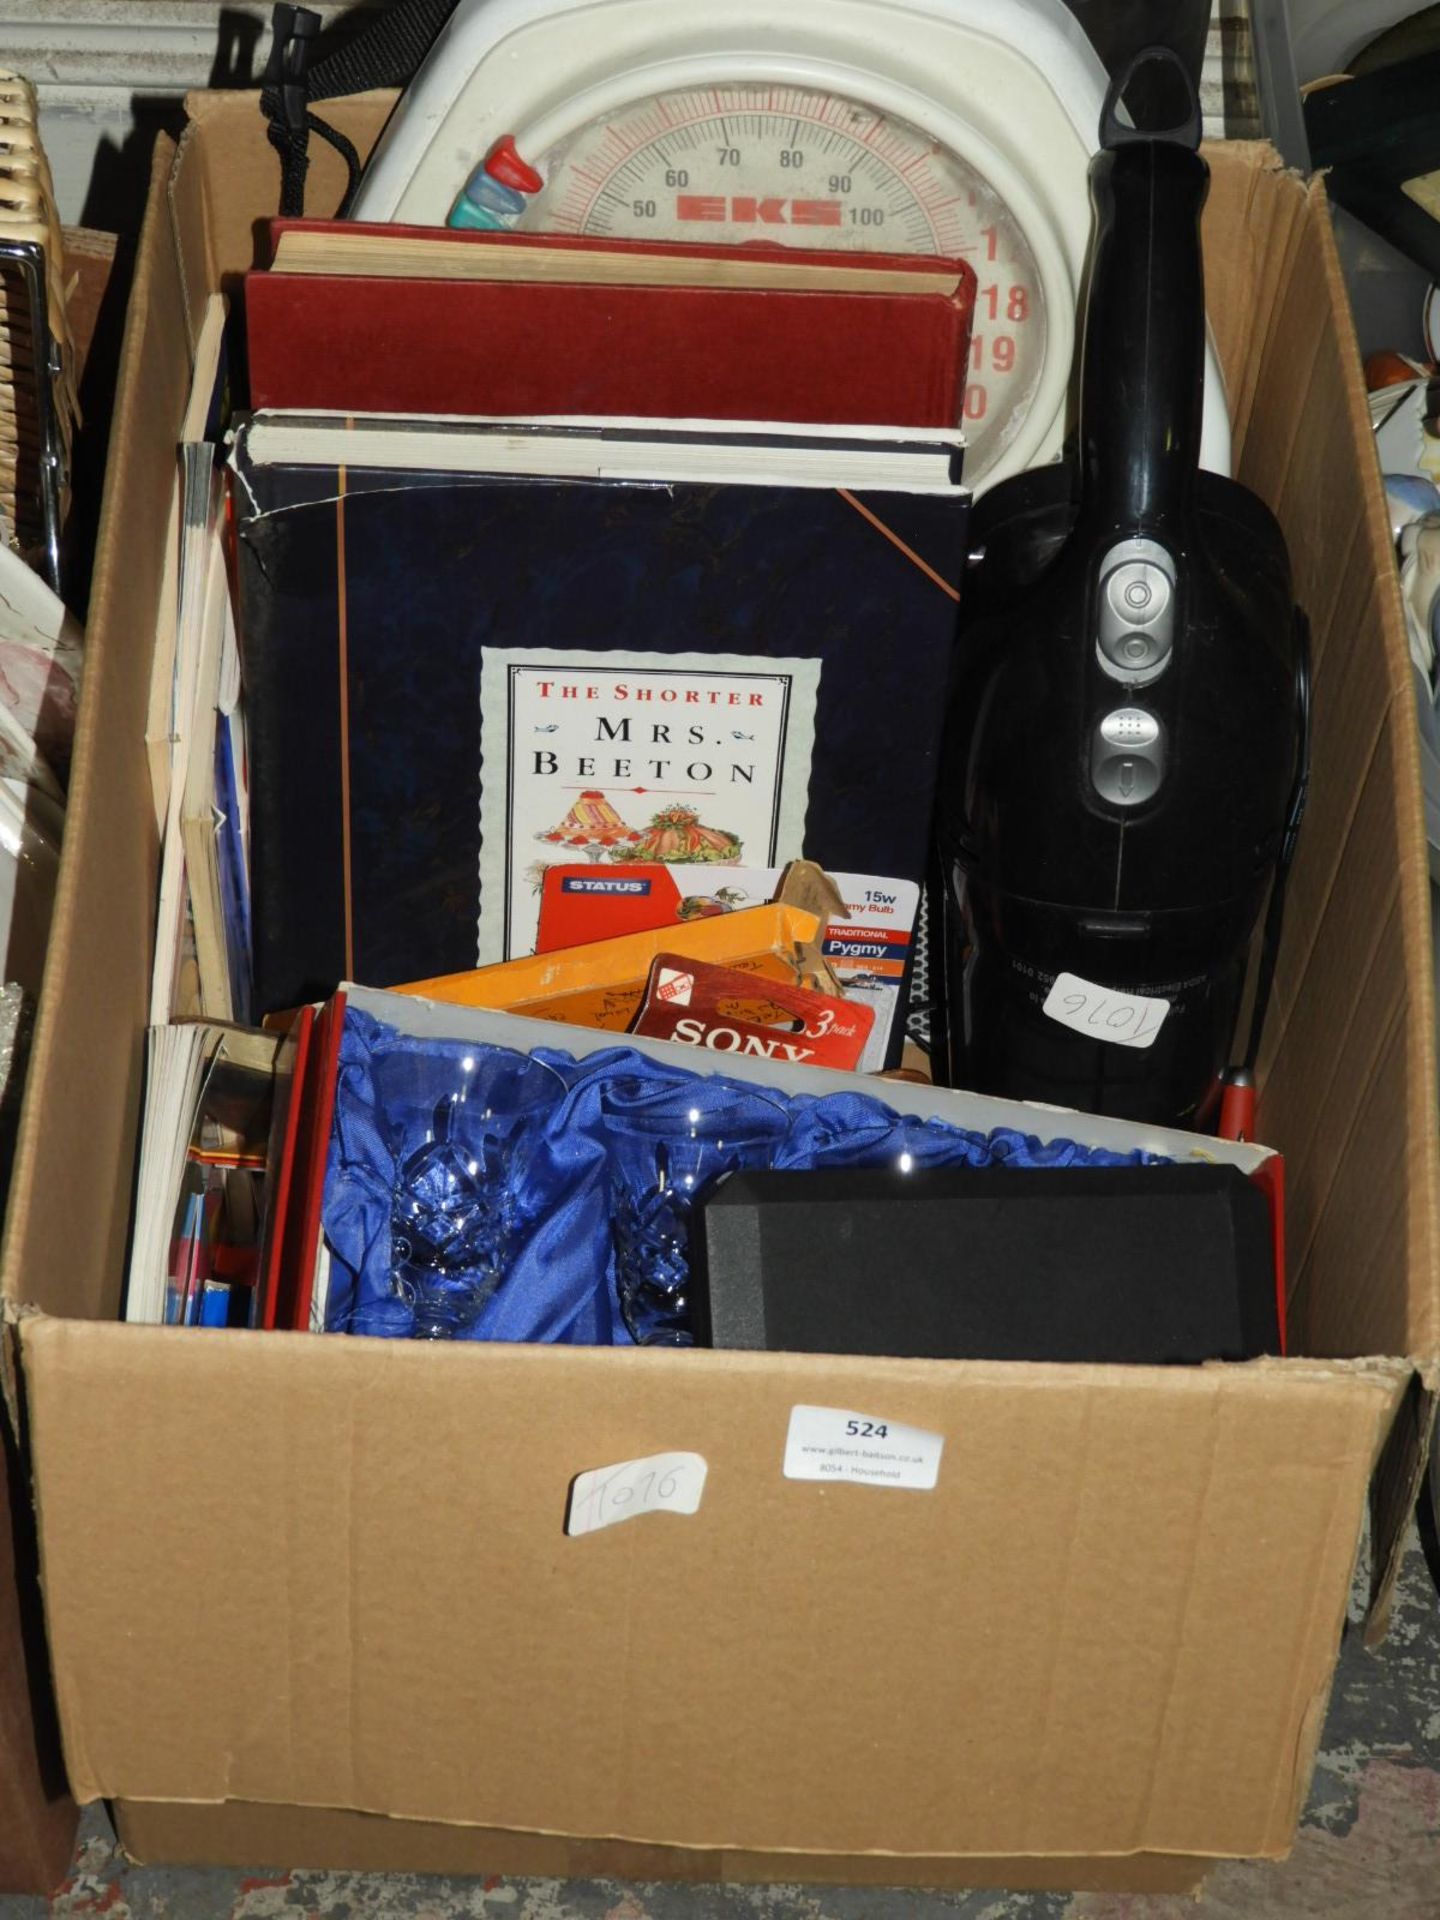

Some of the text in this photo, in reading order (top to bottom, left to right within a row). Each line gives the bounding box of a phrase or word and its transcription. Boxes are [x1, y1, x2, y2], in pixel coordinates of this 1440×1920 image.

[719, 148, 741, 167] 70
[780, 150, 803, 168] 80
[665, 169, 689, 188] 60
[828, 175, 851, 193] 90
[633, 200, 656, 218] 50
[676, 195, 842, 226] EKS
[849, 208, 884, 226] 100
[981, 284, 1030, 323] 18
[970, 334, 1016, 373] 19
[963, 384, 988, 421] 0
[536, 681, 764, 706] THE SHORTER
[594, 716, 723, 745] MRS.
[531, 750, 757, 783] BEETON
[569, 880, 644, 893] STATUS
[868, 903, 895, 915] Bulb
[828, 927, 889, 940] TRADITIONAL
[829, 940, 888, 958] Pygmy
[806, 1009, 835, 1039] 3
[827, 1023, 857, 1038] pack
[669, 1018, 816, 1062] SONY
[845, 1420, 888, 1439] 524
